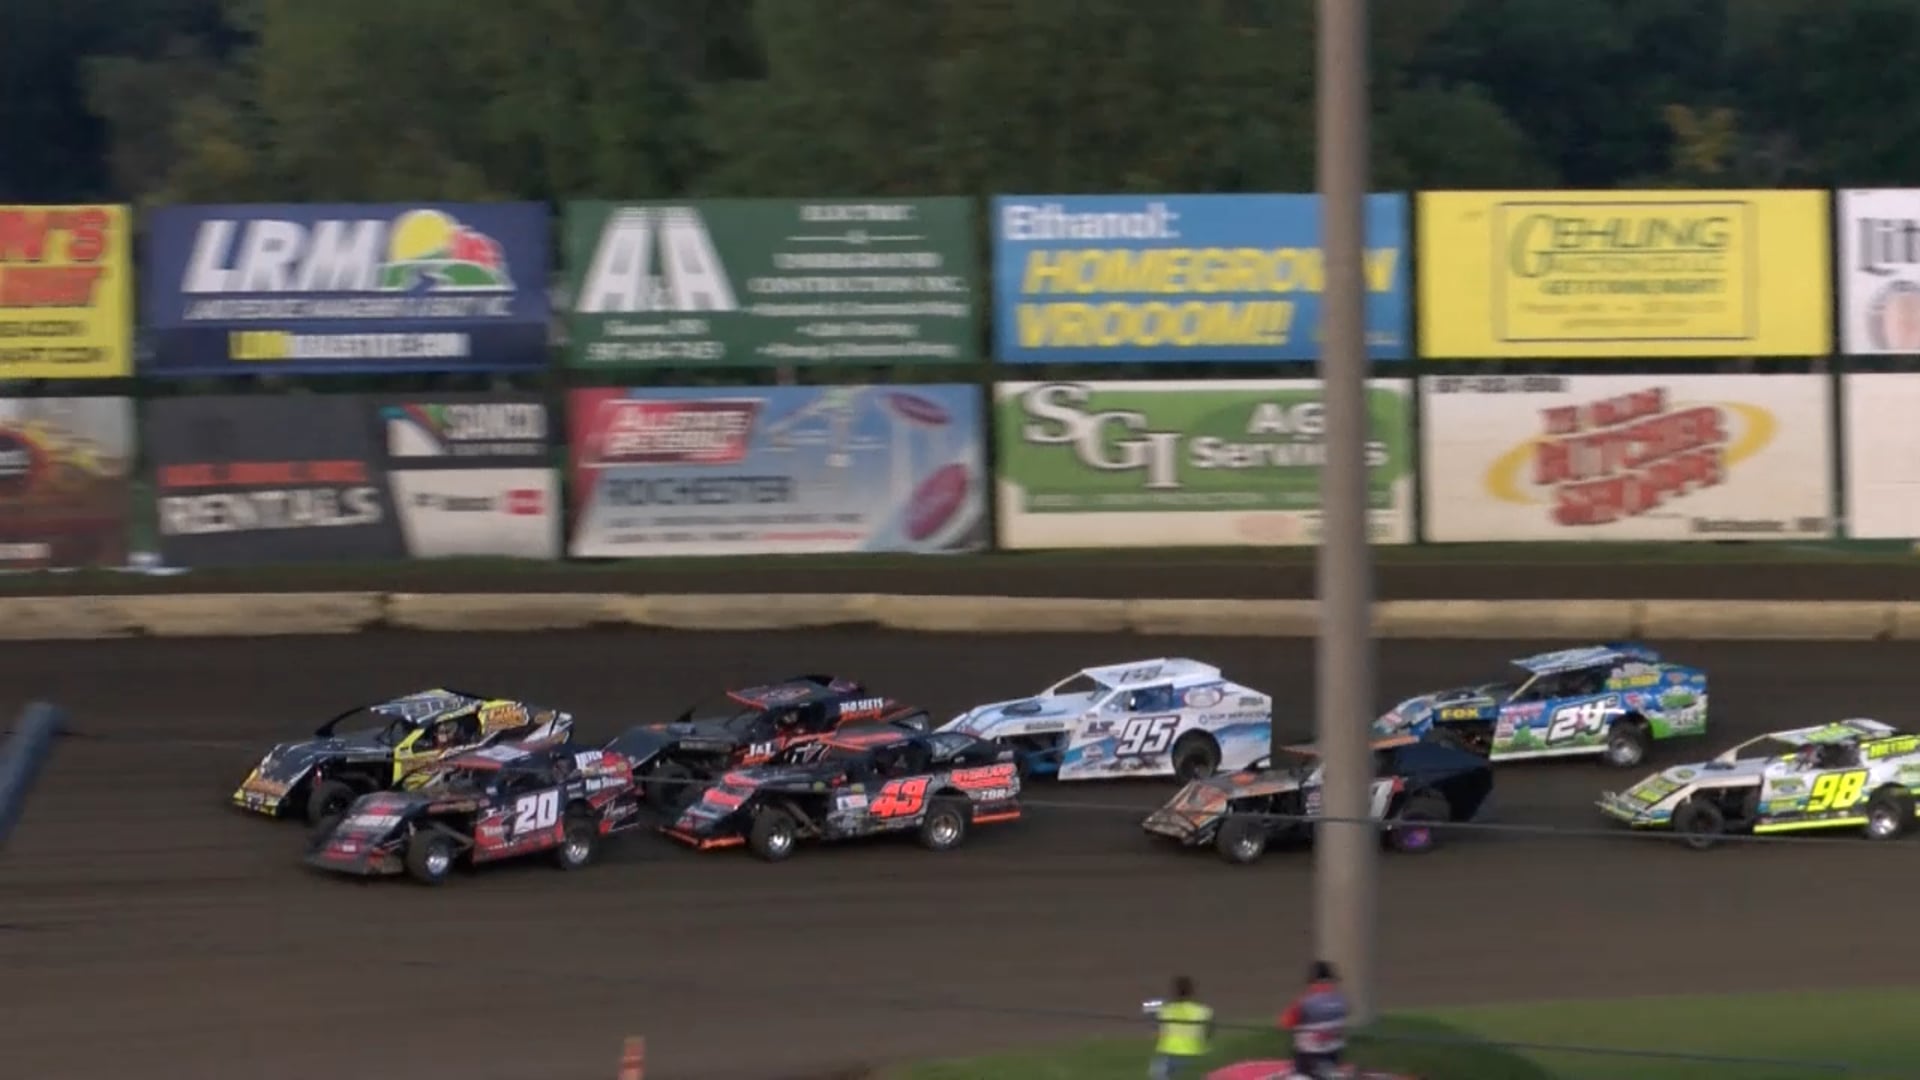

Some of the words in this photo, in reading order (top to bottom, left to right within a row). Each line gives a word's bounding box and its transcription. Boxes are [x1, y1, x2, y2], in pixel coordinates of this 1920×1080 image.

[1003, 203, 1180, 240] Ethanol:
[182, 219, 390, 292] LRM
[1511, 213, 1729, 277] GEHLING
[1021, 383, 1183, 489] SGI
[158, 488, 385, 535] RENTALS
[1115, 715, 1181, 757] 95
[1441, 708, 1479, 719] FOX
[514, 790, 559, 835] 20
[1807, 771, 1868, 812] 98
